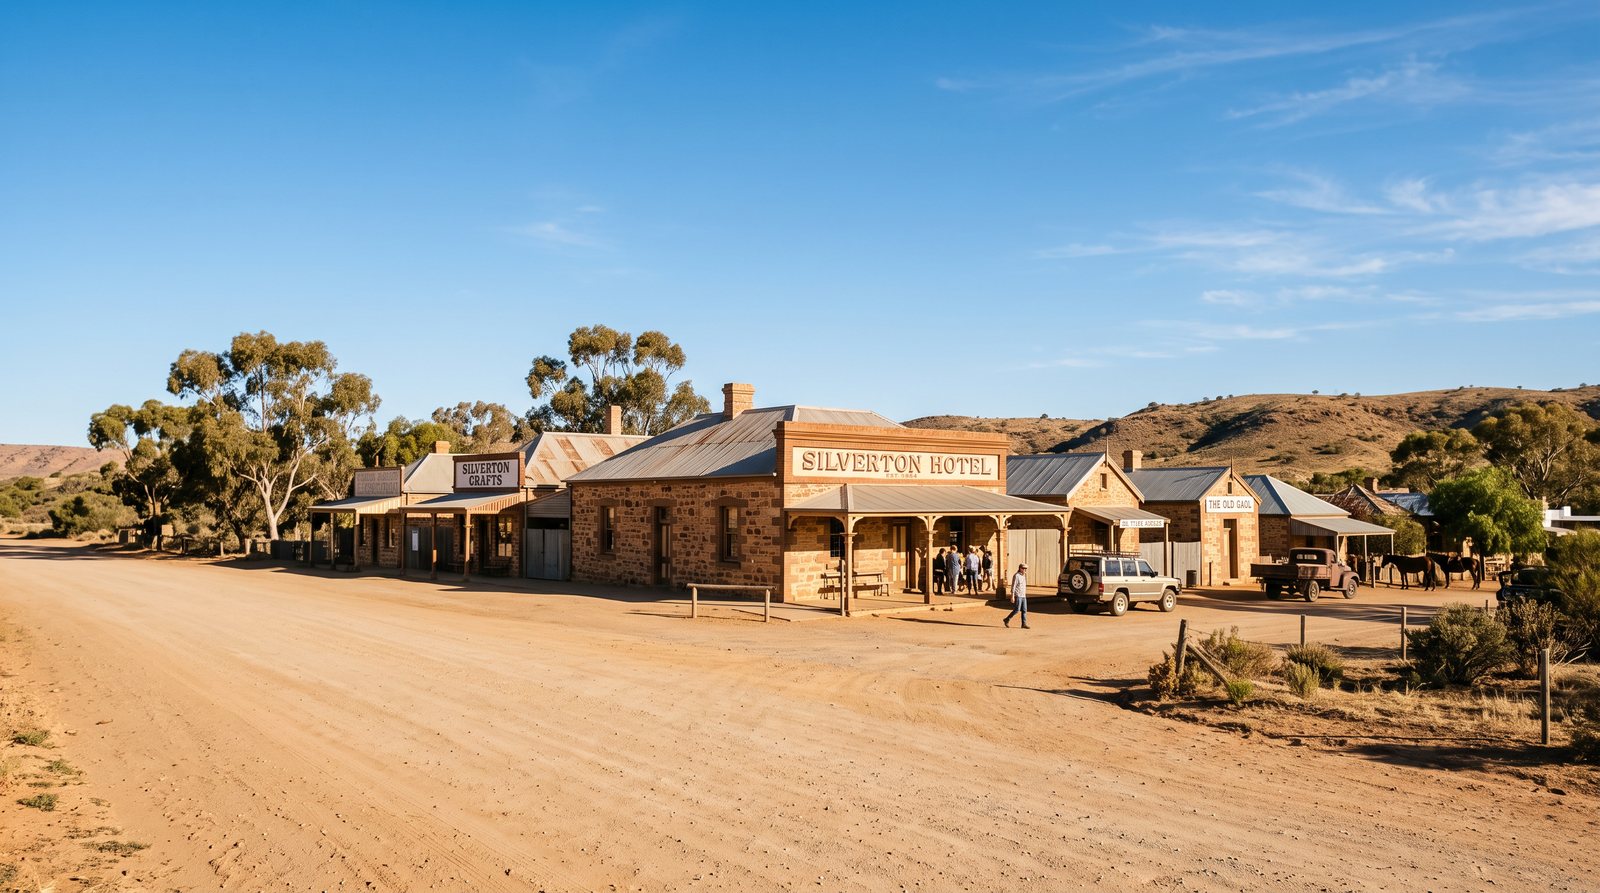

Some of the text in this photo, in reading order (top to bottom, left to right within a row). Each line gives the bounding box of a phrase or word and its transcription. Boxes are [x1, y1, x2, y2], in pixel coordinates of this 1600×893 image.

[462, 461, 510, 474] SILVERTON
[802, 450, 992, 475] SILVERTON HOTEL
[469, 474, 503, 486] CRAFTS
[1209, 499, 1221, 509] THE
[1222, 499, 1235, 509] OLD
